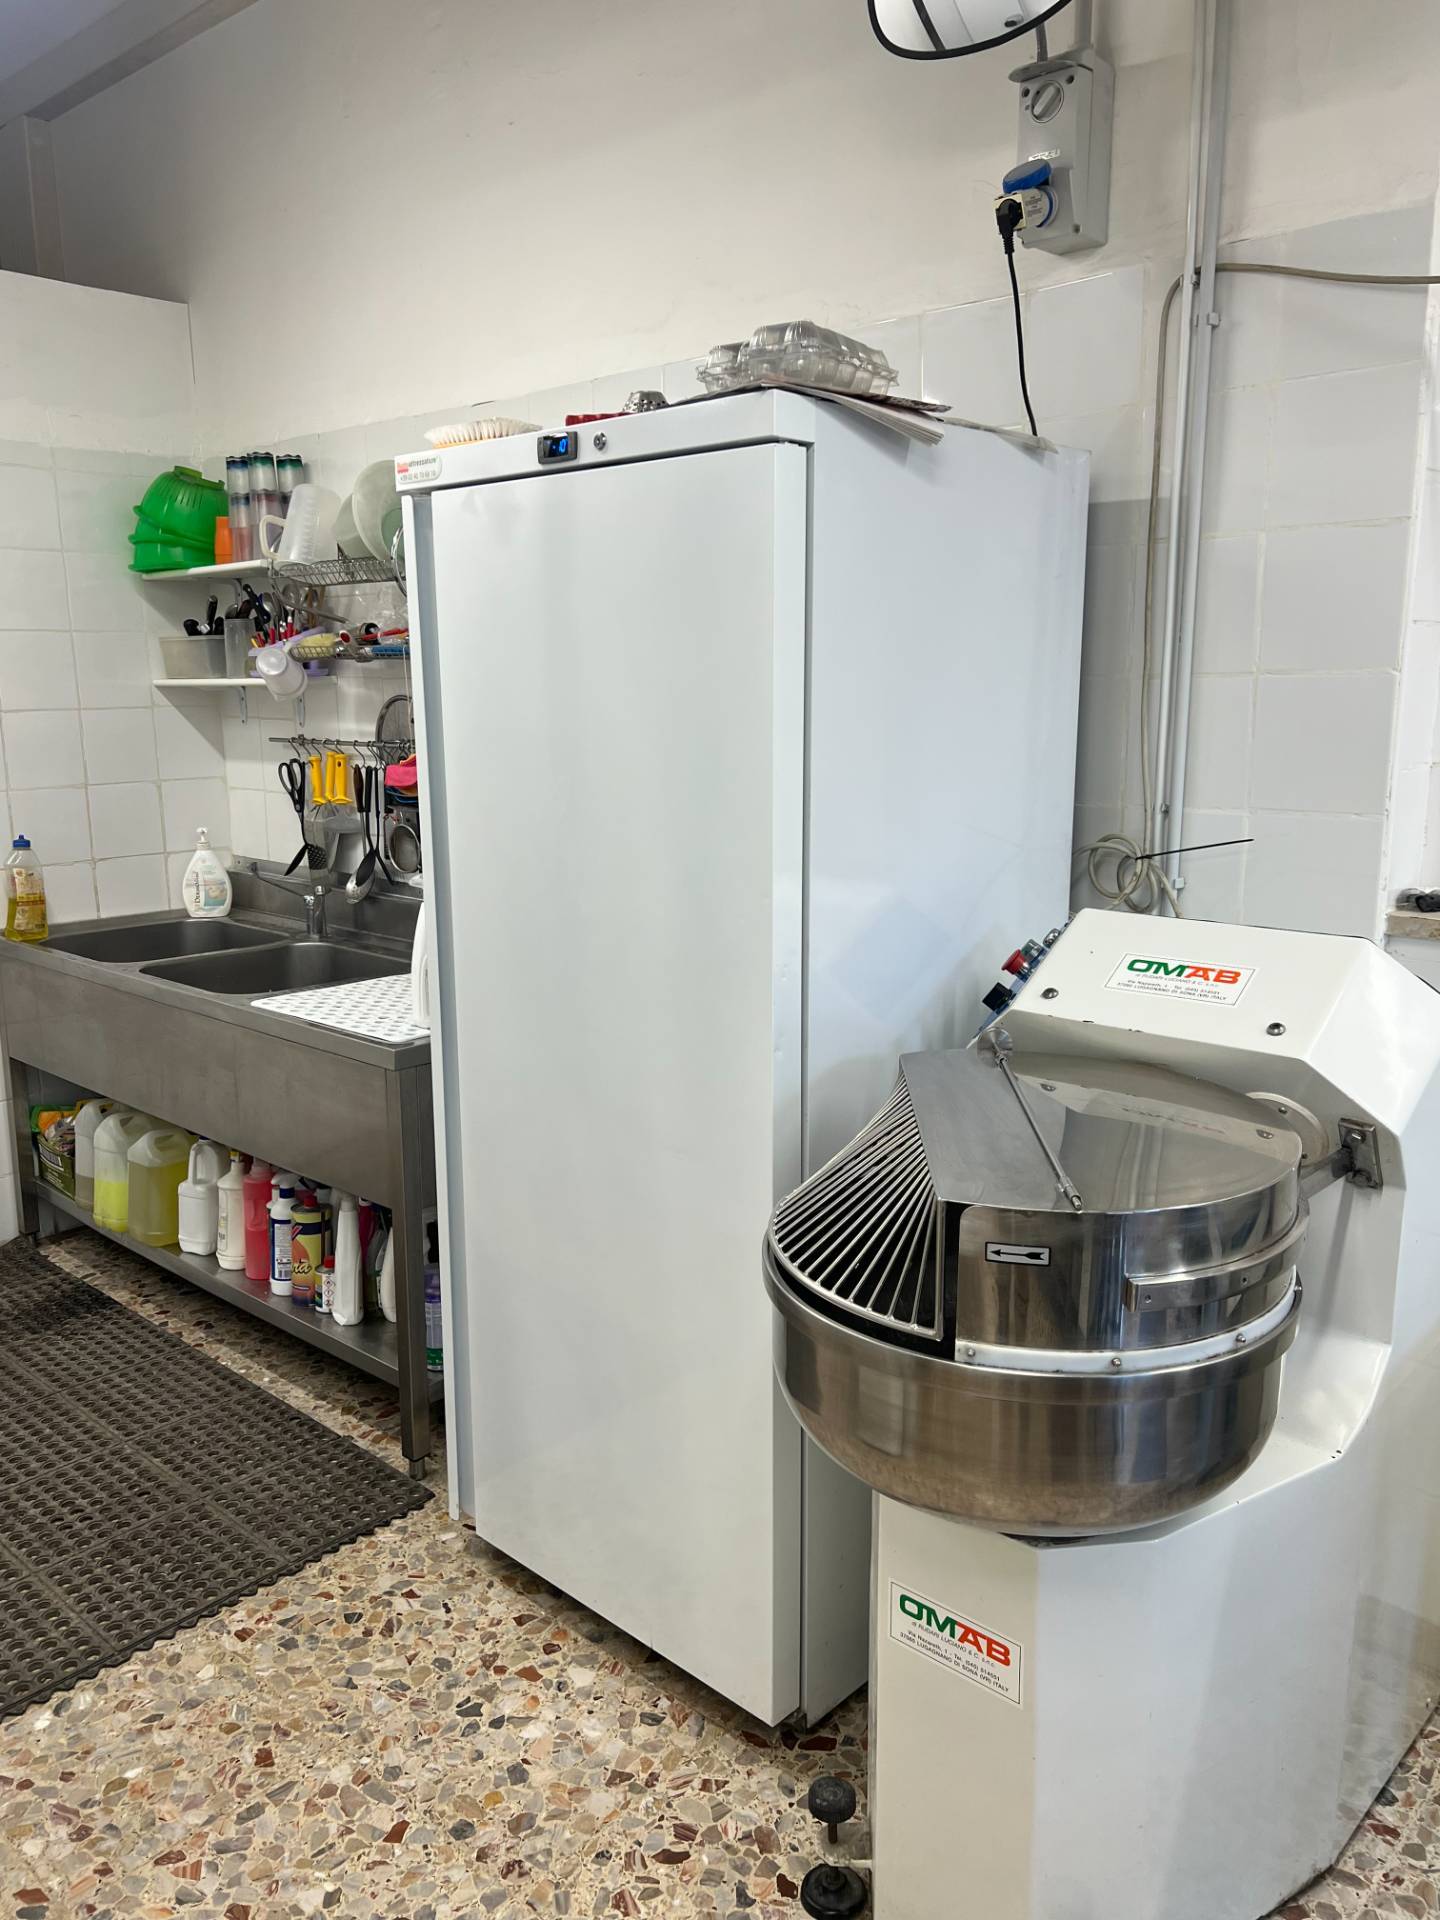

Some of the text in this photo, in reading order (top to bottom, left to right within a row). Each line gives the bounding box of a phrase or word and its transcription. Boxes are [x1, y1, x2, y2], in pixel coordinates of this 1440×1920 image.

[1127, 959, 1241, 984] OMAB
[899, 1593, 1011, 1667] OMAB
[941, 1636, 966, 1653] LUCIANO
[962, 1664, 977, 1676] SONA
[993, 1681, 1008, 1693] ITALY
